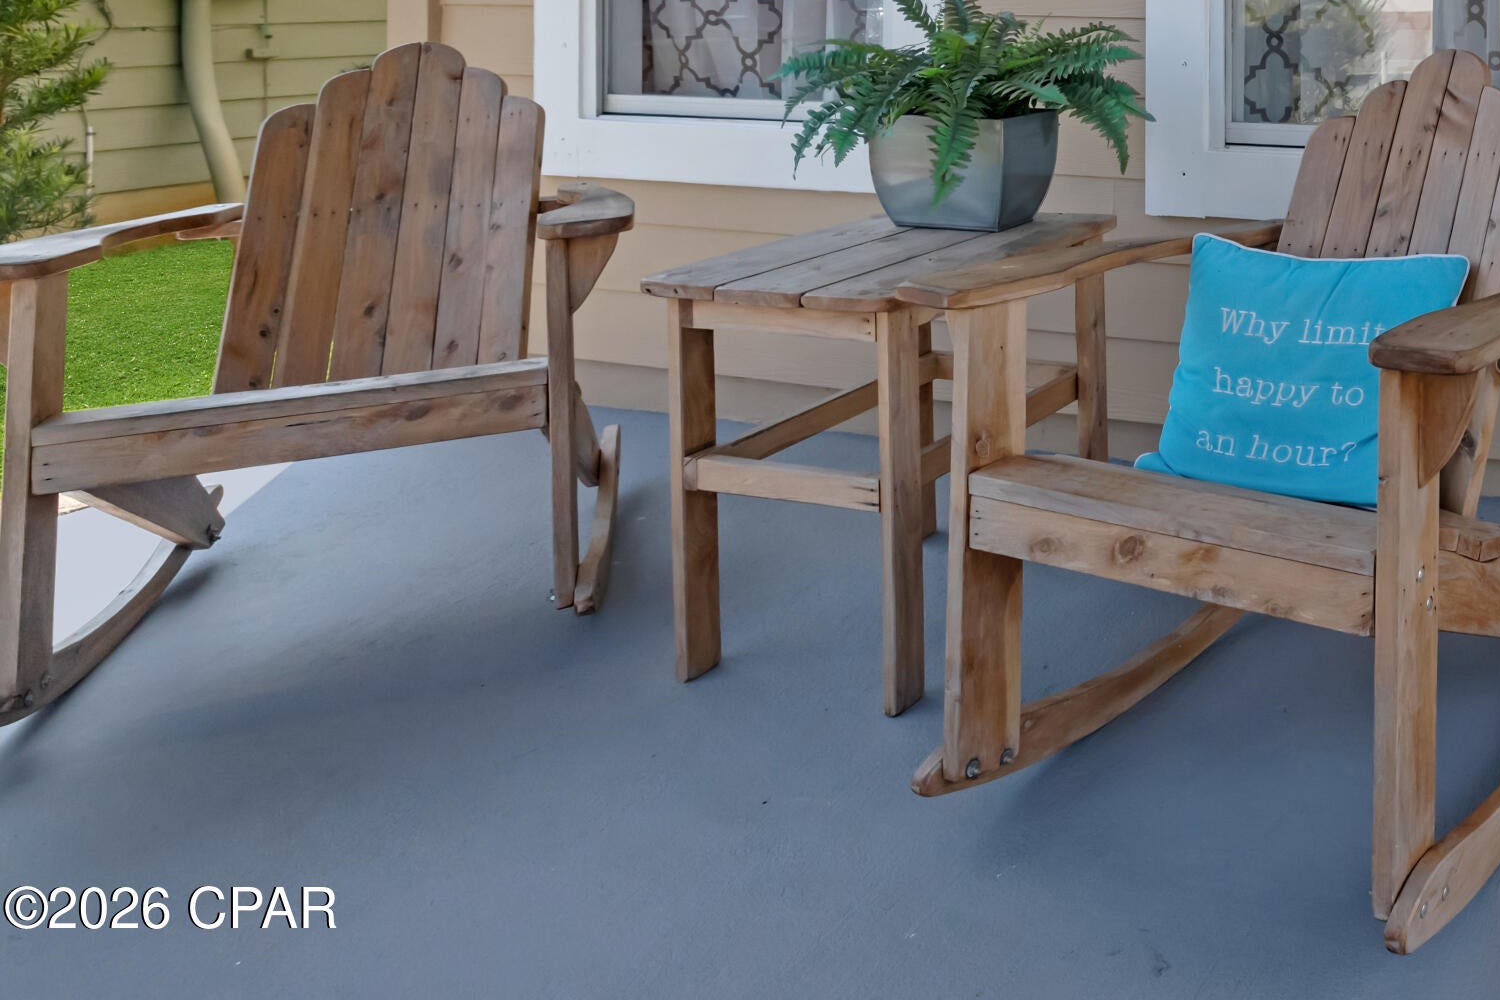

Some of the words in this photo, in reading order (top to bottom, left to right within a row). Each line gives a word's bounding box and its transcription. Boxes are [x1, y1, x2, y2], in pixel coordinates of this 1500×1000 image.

[1220, 307, 1290, 345] Why
[1212, 366, 1320, 408] happy
[1331, 381, 1365, 407] to
[1195, 430, 1236, 457] an
[1245, 433, 1357, 467] hour?
